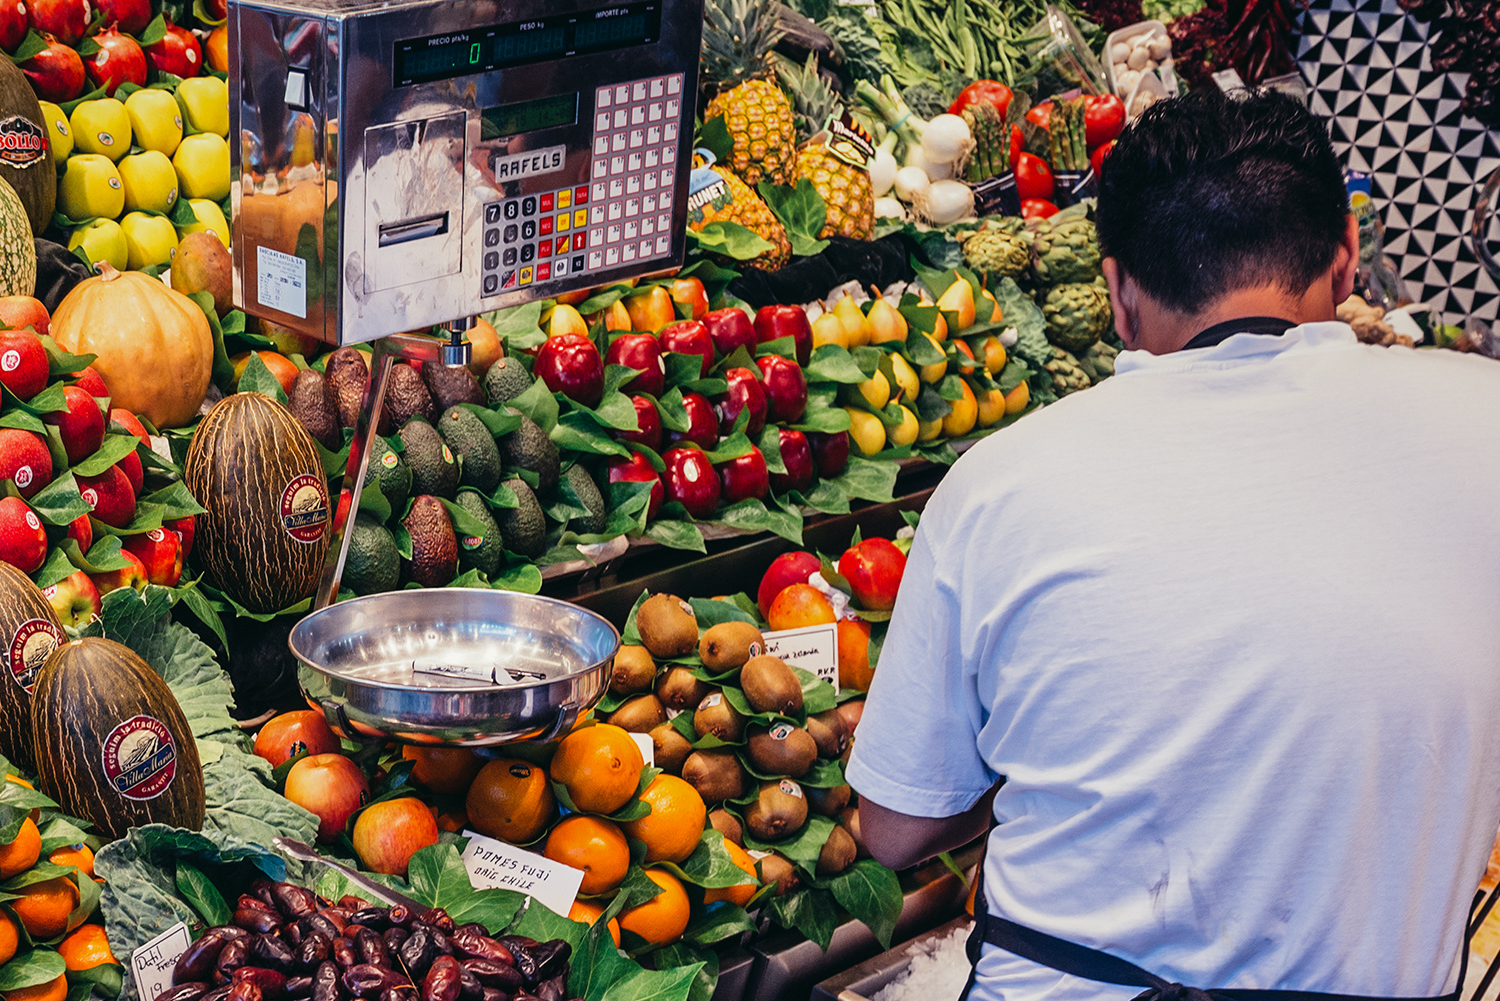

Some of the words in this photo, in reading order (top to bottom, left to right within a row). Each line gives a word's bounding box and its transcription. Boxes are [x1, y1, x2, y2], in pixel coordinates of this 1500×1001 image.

[520, 22, 536, 31] PESO
[428, 36, 450, 46] PRECIO
[500, 152, 561, 178] RAFELS
[490, 208, 497, 220] 7
[508, 204, 514, 217] 8
[526, 202, 532, 213] 9
[526, 225, 532, 236] 6
[507, 252, 513, 263] 2
[525, 248, 531, 259] 3
[109, 734, 122, 770] seguim
[120, 726, 131, 735] la
[473, 846, 519, 870] POMES
